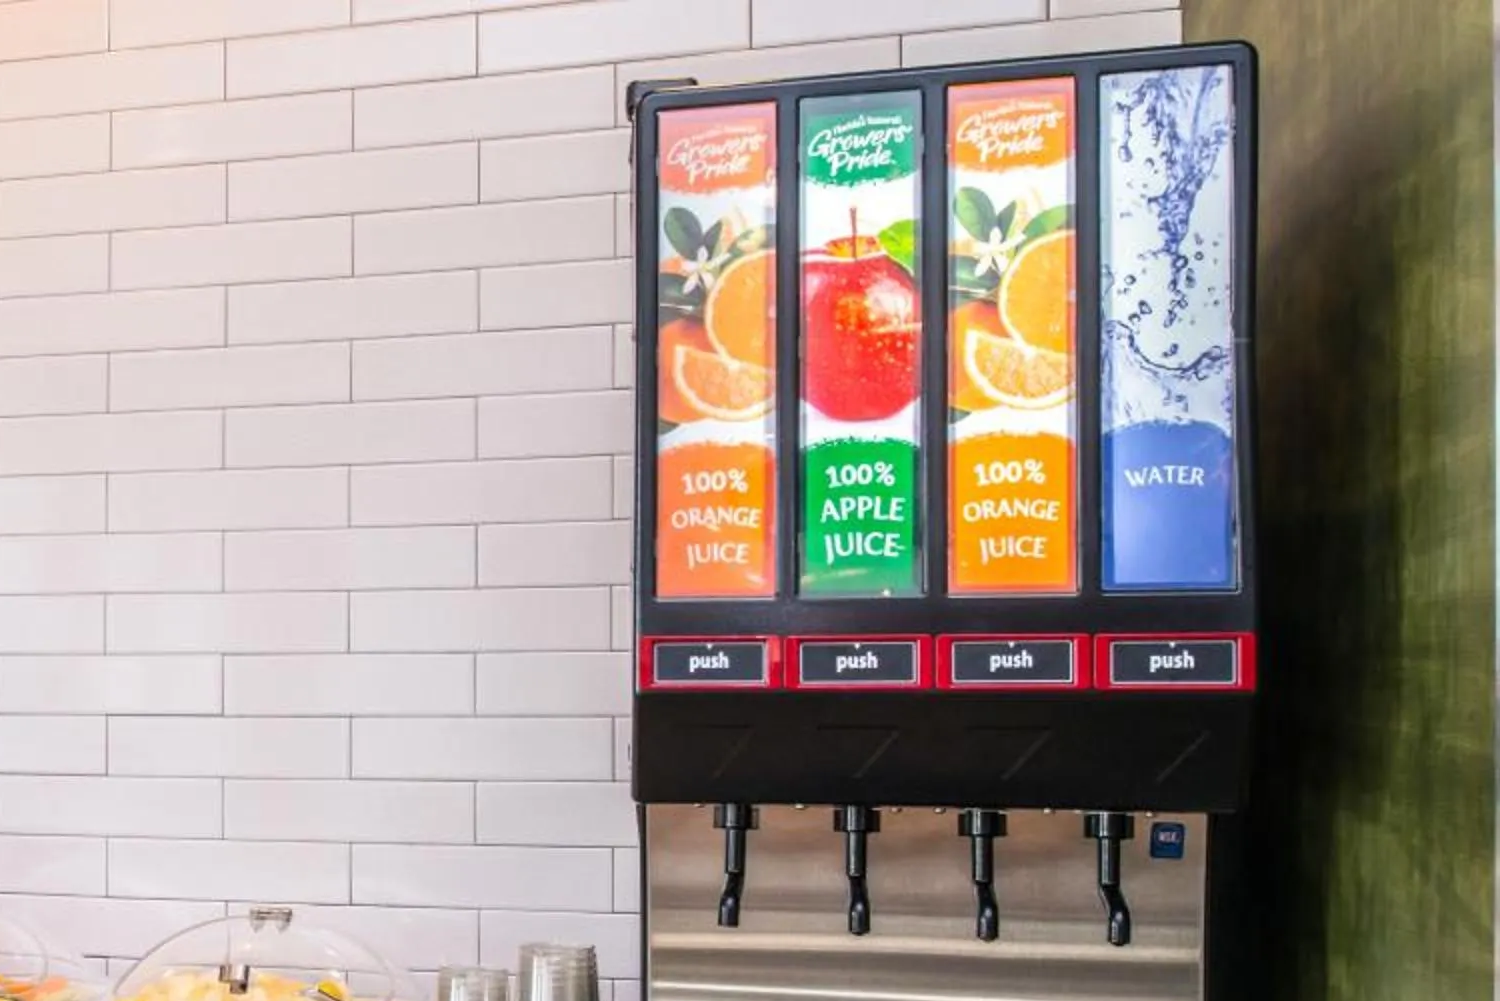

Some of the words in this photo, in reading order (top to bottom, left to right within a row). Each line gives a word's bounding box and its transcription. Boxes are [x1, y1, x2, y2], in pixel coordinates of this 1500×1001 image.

[976, 131, 1045, 162] Pride
[685, 154, 751, 185] Pride
[827, 145, 891, 177] Pride
[681, 467, 749, 496] 100%
[825, 461, 896, 489] 100%
[973, 458, 1046, 488] 100%
[1123, 464, 1206, 488] WATER
[671, 505, 761, 530] ORANGE
[820, 496, 906, 523] APPLE
[963, 497, 1060, 523] ORANGE
[686, 542, 749, 570] JUICE
[824, 531, 901, 566] JUICE
[979, 535, 1047, 566] JUICE
[689, 652, 730, 673] push
[836, 652, 879, 673] push
[989, 650, 1034, 673] push
[1149, 650, 1196, 673] push
